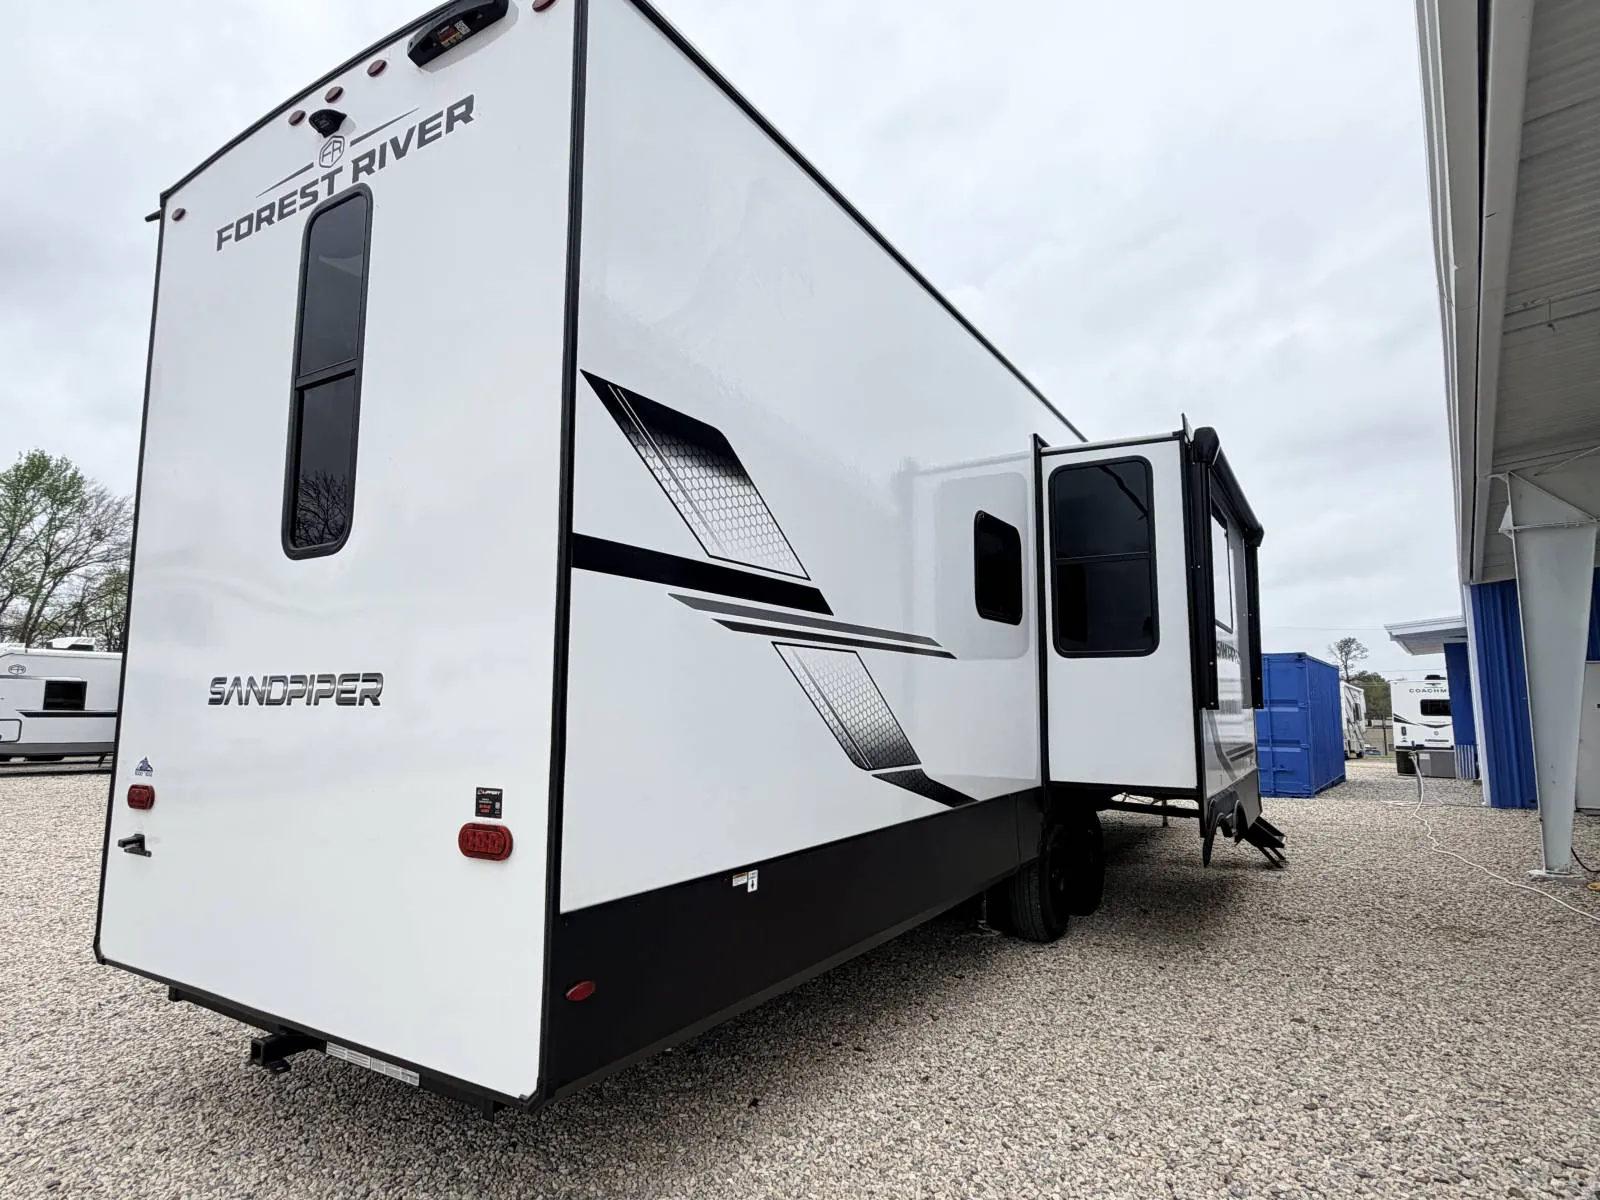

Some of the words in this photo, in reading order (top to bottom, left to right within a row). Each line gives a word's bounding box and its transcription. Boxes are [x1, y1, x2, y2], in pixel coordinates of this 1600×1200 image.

[216, 165, 343, 252] FOREST
[351, 94, 475, 184] RIVER
[207, 672, 384, 706] SANDPIPER
